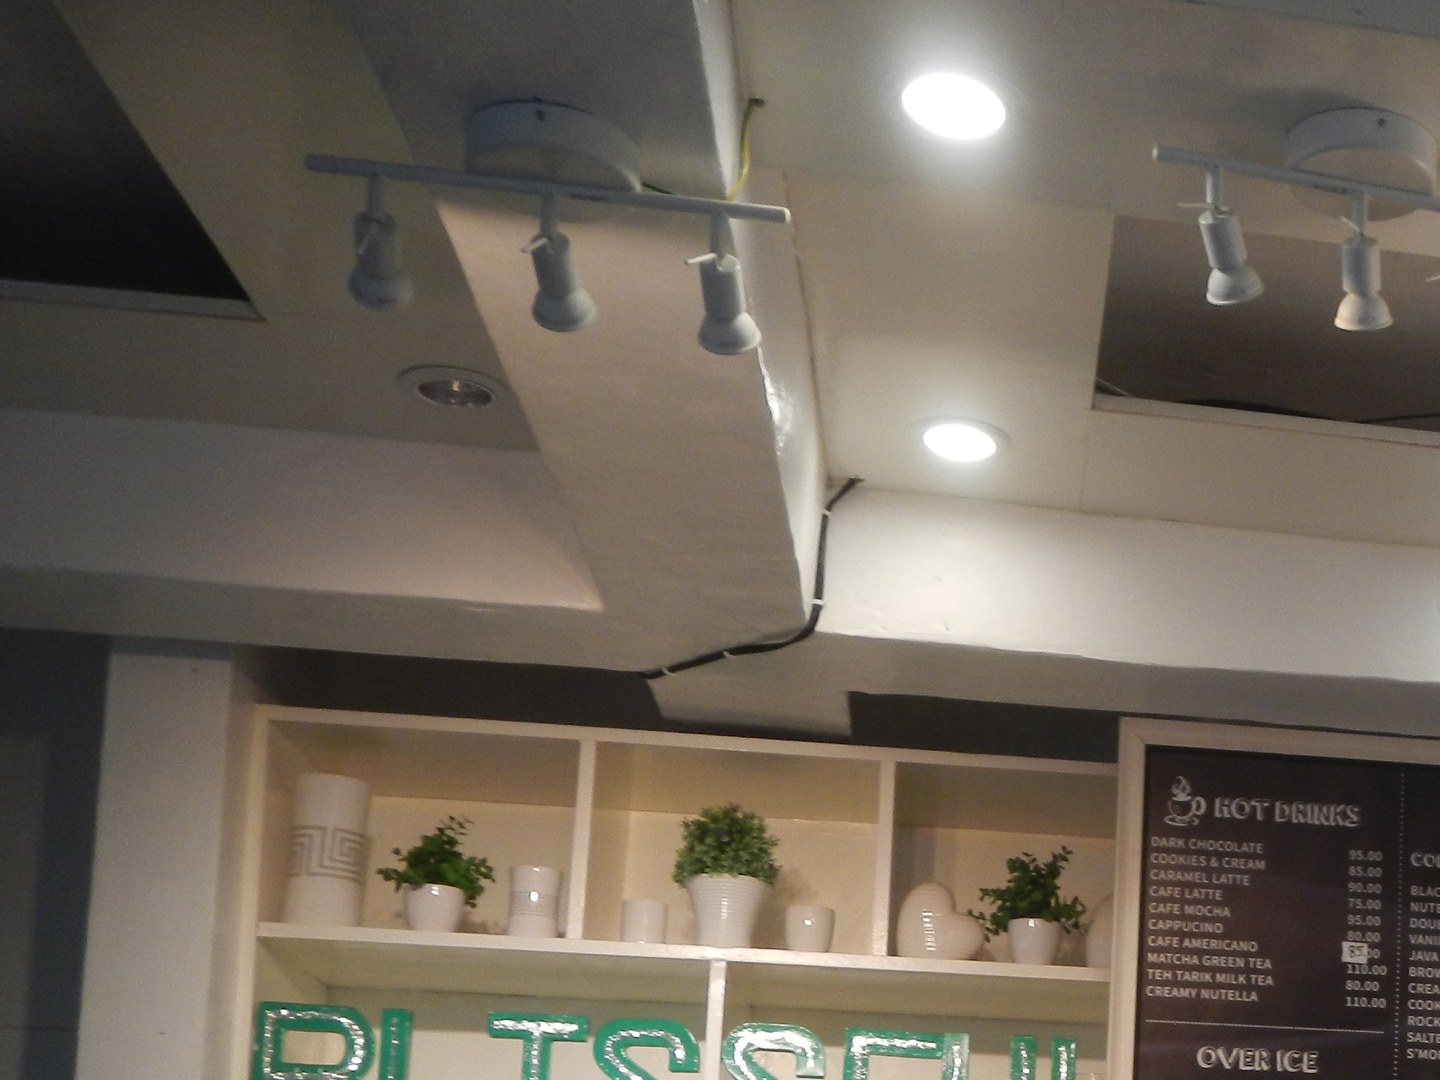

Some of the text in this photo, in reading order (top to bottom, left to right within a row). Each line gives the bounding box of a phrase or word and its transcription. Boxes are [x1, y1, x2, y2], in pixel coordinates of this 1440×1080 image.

[1275, 802, 1361, 826] DRINKS
[1152, 837, 1263, 853] DARK CHOCOLATE
[1151, 853, 1265, 870] COOKIES CREAM
[1151, 870, 1249, 885] CARAMEL LATTE
[1151, 886, 1222, 900] CAFE LATTE
[1150, 903, 1180, 914] CAFE
[1185, 905, 1230, 917] MOCHA
[1149, 919, 1223, 933] CAPPUCINO
[1148, 936, 1258, 952] CAFE AMERICANO
[1148, 953, 1199, 965] MATCHA
[1202, 956, 1245, 968] GREEN
[1249, 958, 1272, 969] TEA
[1409, 951, 1439, 962] JAVA
[1148, 969, 1274, 985] TEH TARIK MILK TEA
[1146, 986, 1197, 999] CREAMY
[1201, 988, 1258, 1001] NUTELLA
[1197, 1045, 1318, 1074] OVER ICE
